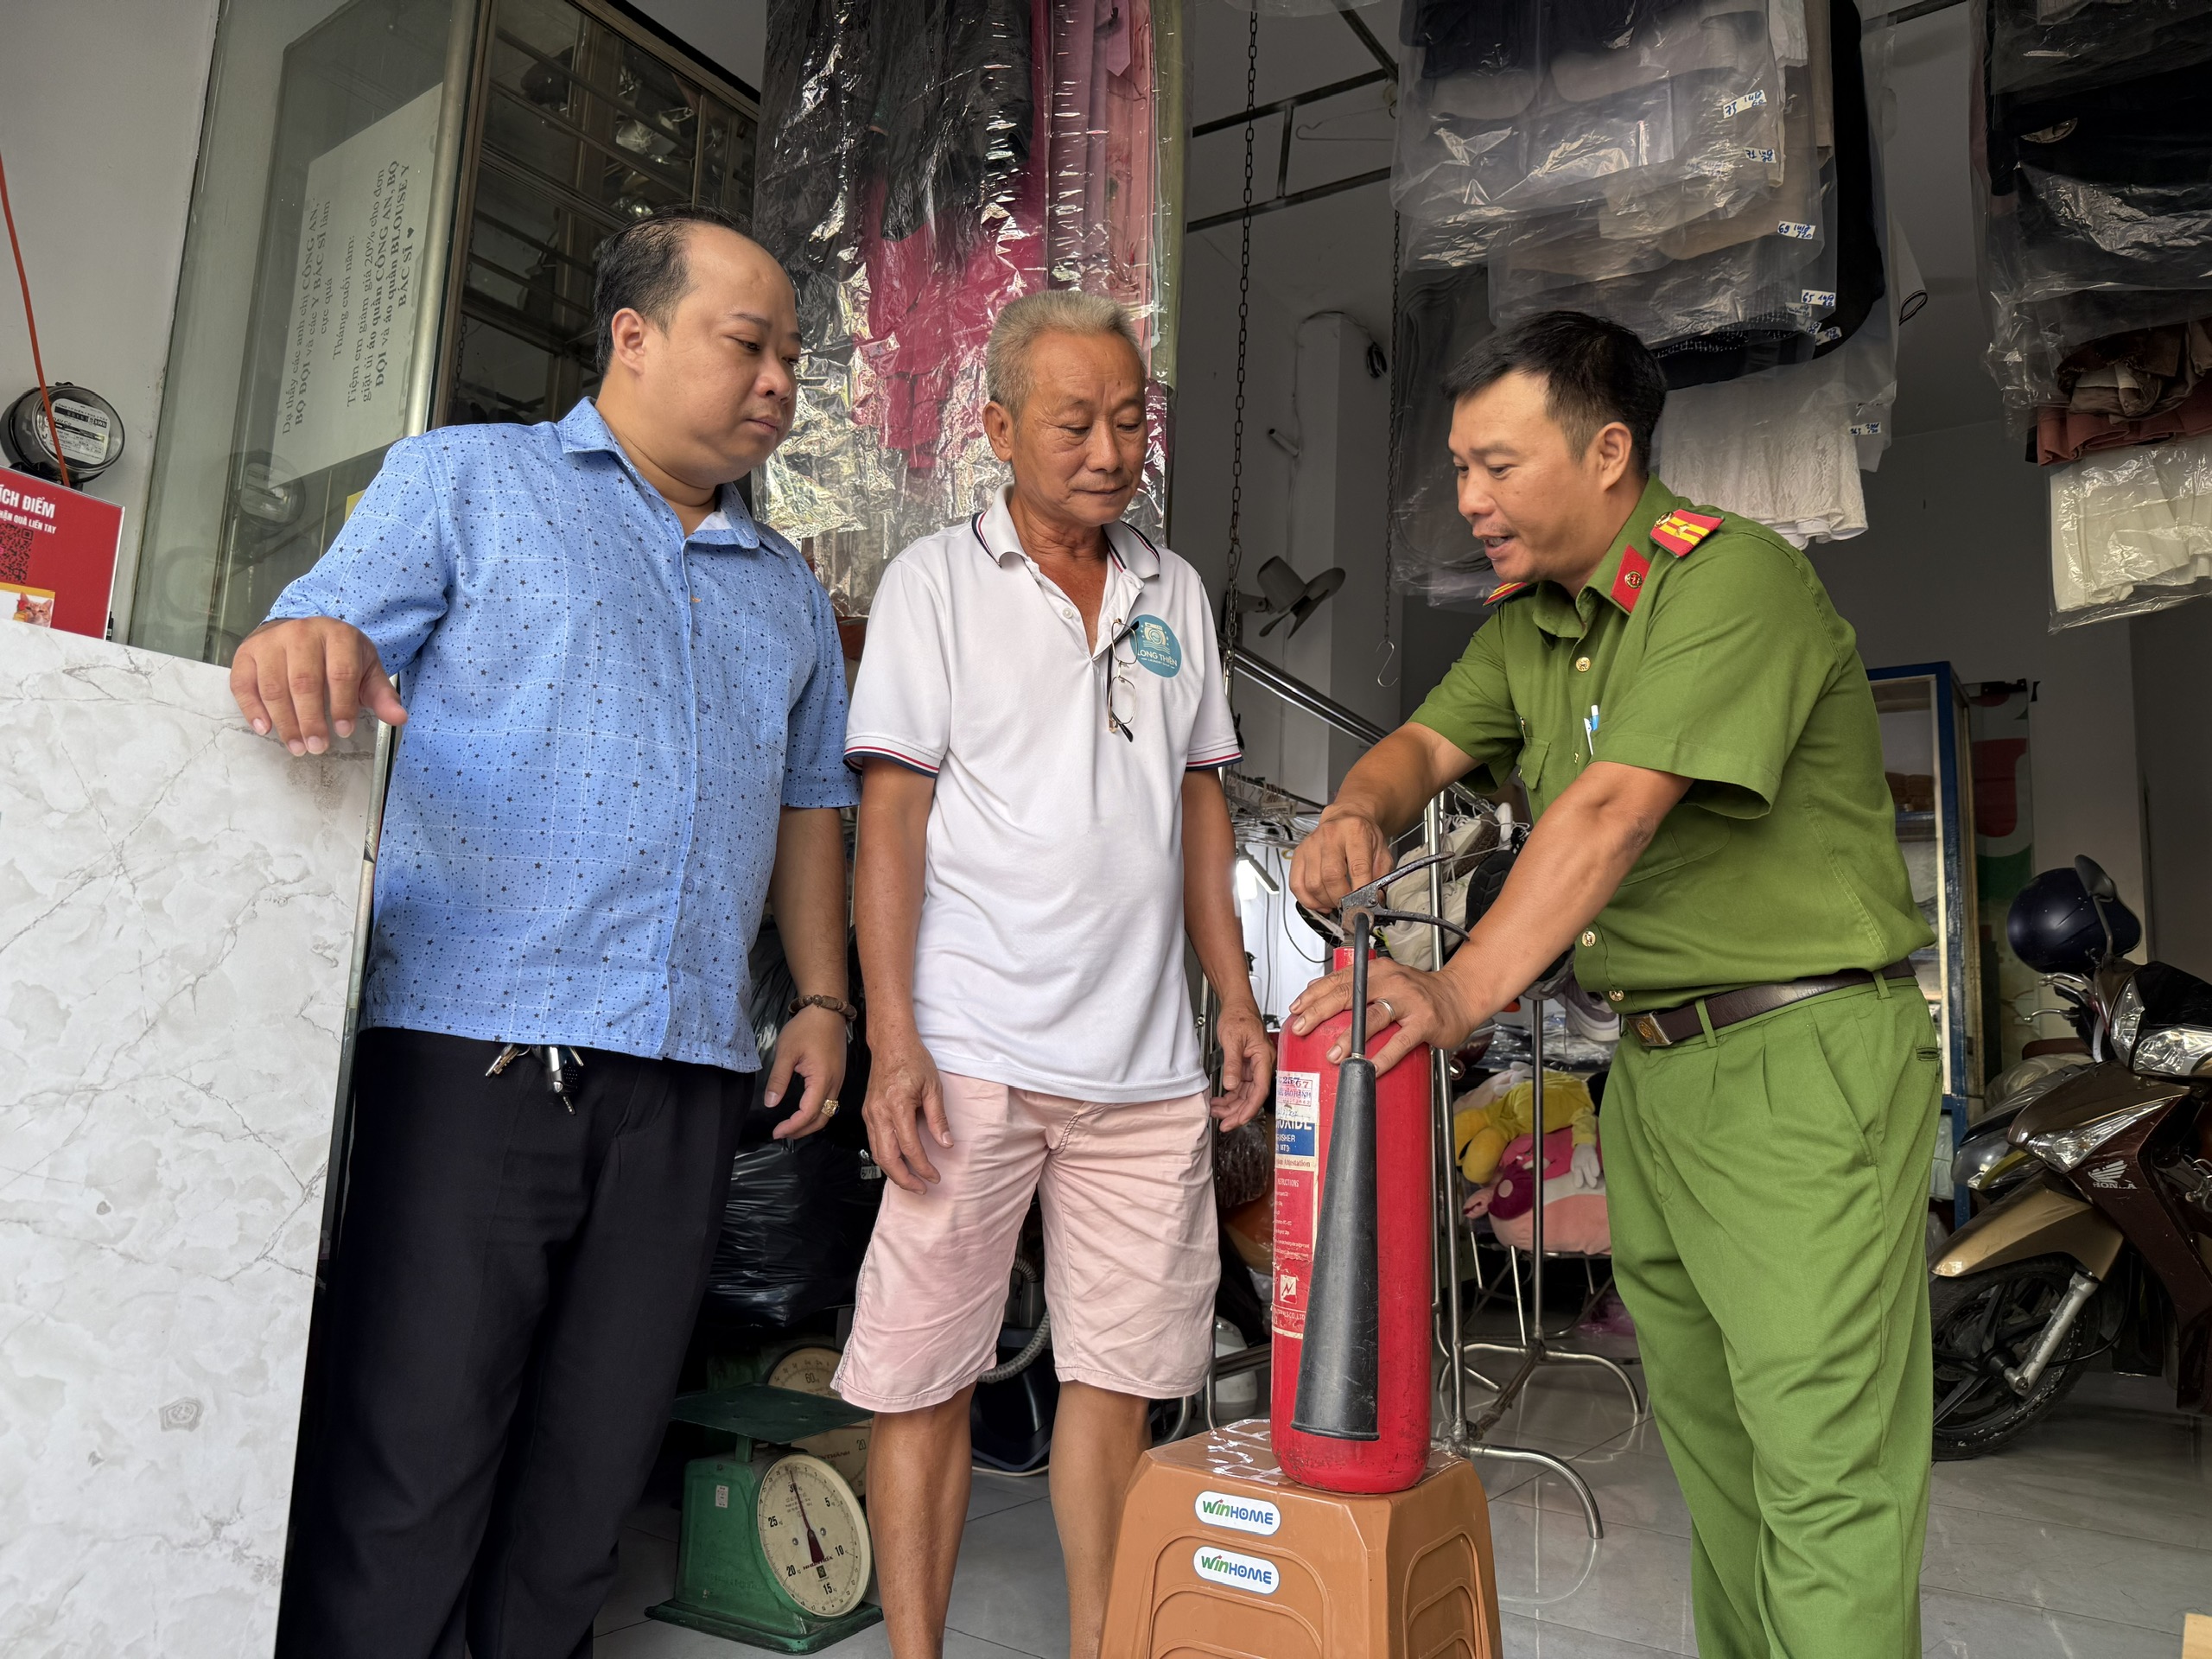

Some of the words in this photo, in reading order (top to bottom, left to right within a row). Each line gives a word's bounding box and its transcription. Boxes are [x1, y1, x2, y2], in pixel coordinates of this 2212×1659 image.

[400, 165, 410, 177] Y
[369, 201, 379, 227] cho
[391, 180, 408, 256] BLOUSE
[364, 231, 375, 267] 20%
[313, 253, 324, 290] BÁC
[296, 321, 305, 346] anh
[302, 238, 315, 289] CÔNG
[333, 311, 349, 359] Tháng
[346, 236, 355, 271] năm:
[367, 331, 377, 350] áo
[375, 226, 388, 282] CÔNG
[397, 267, 410, 308] BÁC
[311, 296, 319, 308] Y
[384, 305, 393, 323] áo
[380, 327, 390, 346] và
[355, 338, 363, 361] em
[347, 365, 359, 407] Tiệm
[22, 494, 55, 518] ĐIỂM
[44, 524, 56, 534] TAY
[824, 1497, 830, 1507] 5
[767, 1516, 778, 1528] 25
[835, 1545, 845, 1556] 10
[786, 1565, 796, 1577] 20
[823, 1583, 833, 1595] 15
